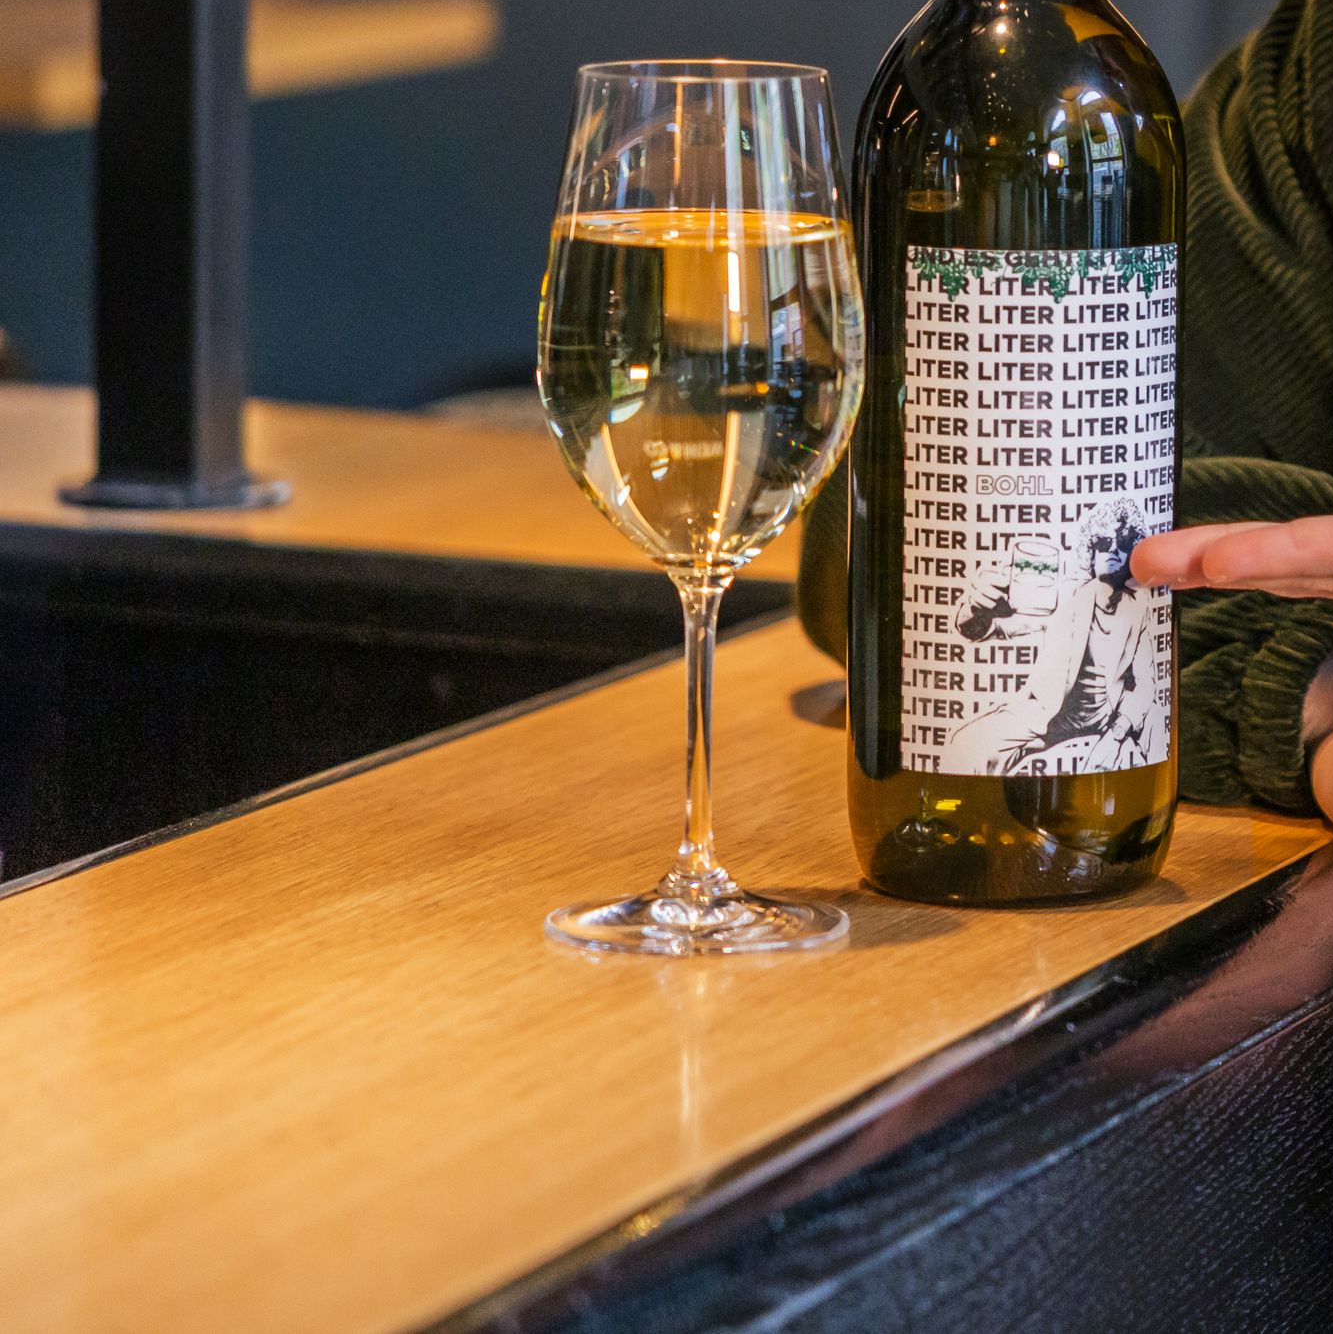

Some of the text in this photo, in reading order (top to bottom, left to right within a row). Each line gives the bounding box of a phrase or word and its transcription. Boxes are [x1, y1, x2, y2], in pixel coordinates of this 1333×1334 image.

[980, 277, 1052, 296] LITER
[906, 298, 1177, 324] LITER LITER LITER LITER
[905, 326, 1177, 352] LITER LITER LITER LITER
[905, 354, 1176, 381] LITER LITER LITER LITER
[905, 381, 1176, 409] LITER LITER LITER LITER
[905, 410, 1175, 438] LITER LITER LITER LITER
[905, 438, 1174, 466] LITER LITER LITER LITER
[904, 465, 1174, 495] LITER BOHL LITER LITER
[904, 498, 967, 521] LITER
[976, 503, 1051, 523] LITER
[904, 526, 966, 550] LITER
[904, 556, 966, 577] LITER
[903, 640, 964, 663] LITER
[902, 667, 964, 690] LITER
[902, 695, 964, 718] LITER
